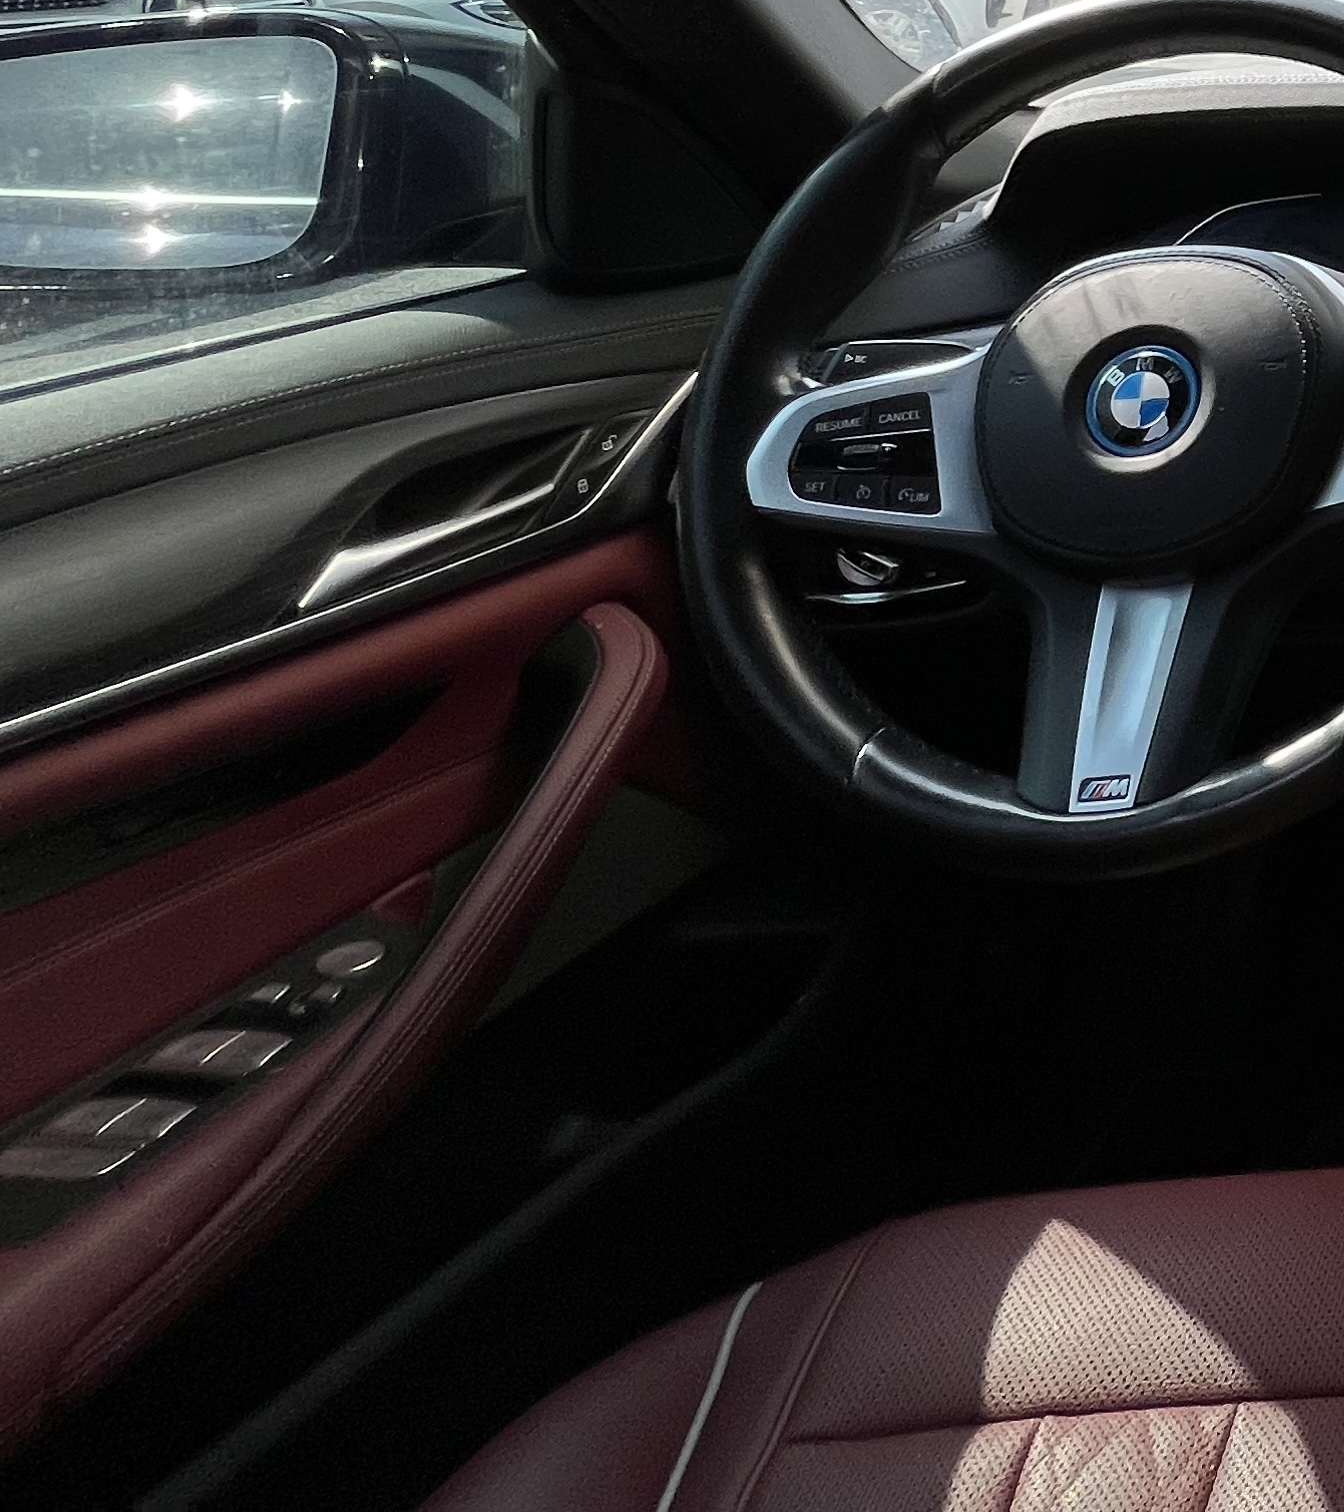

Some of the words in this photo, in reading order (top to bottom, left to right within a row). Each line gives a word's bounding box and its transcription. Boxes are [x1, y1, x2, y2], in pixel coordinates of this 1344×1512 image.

[1106, 356, 1182, 387] BMW
[878, 409, 922, 424] CANCEL
[815, 417, 862, 434] RESUME
[805, 481, 826, 493] SET
